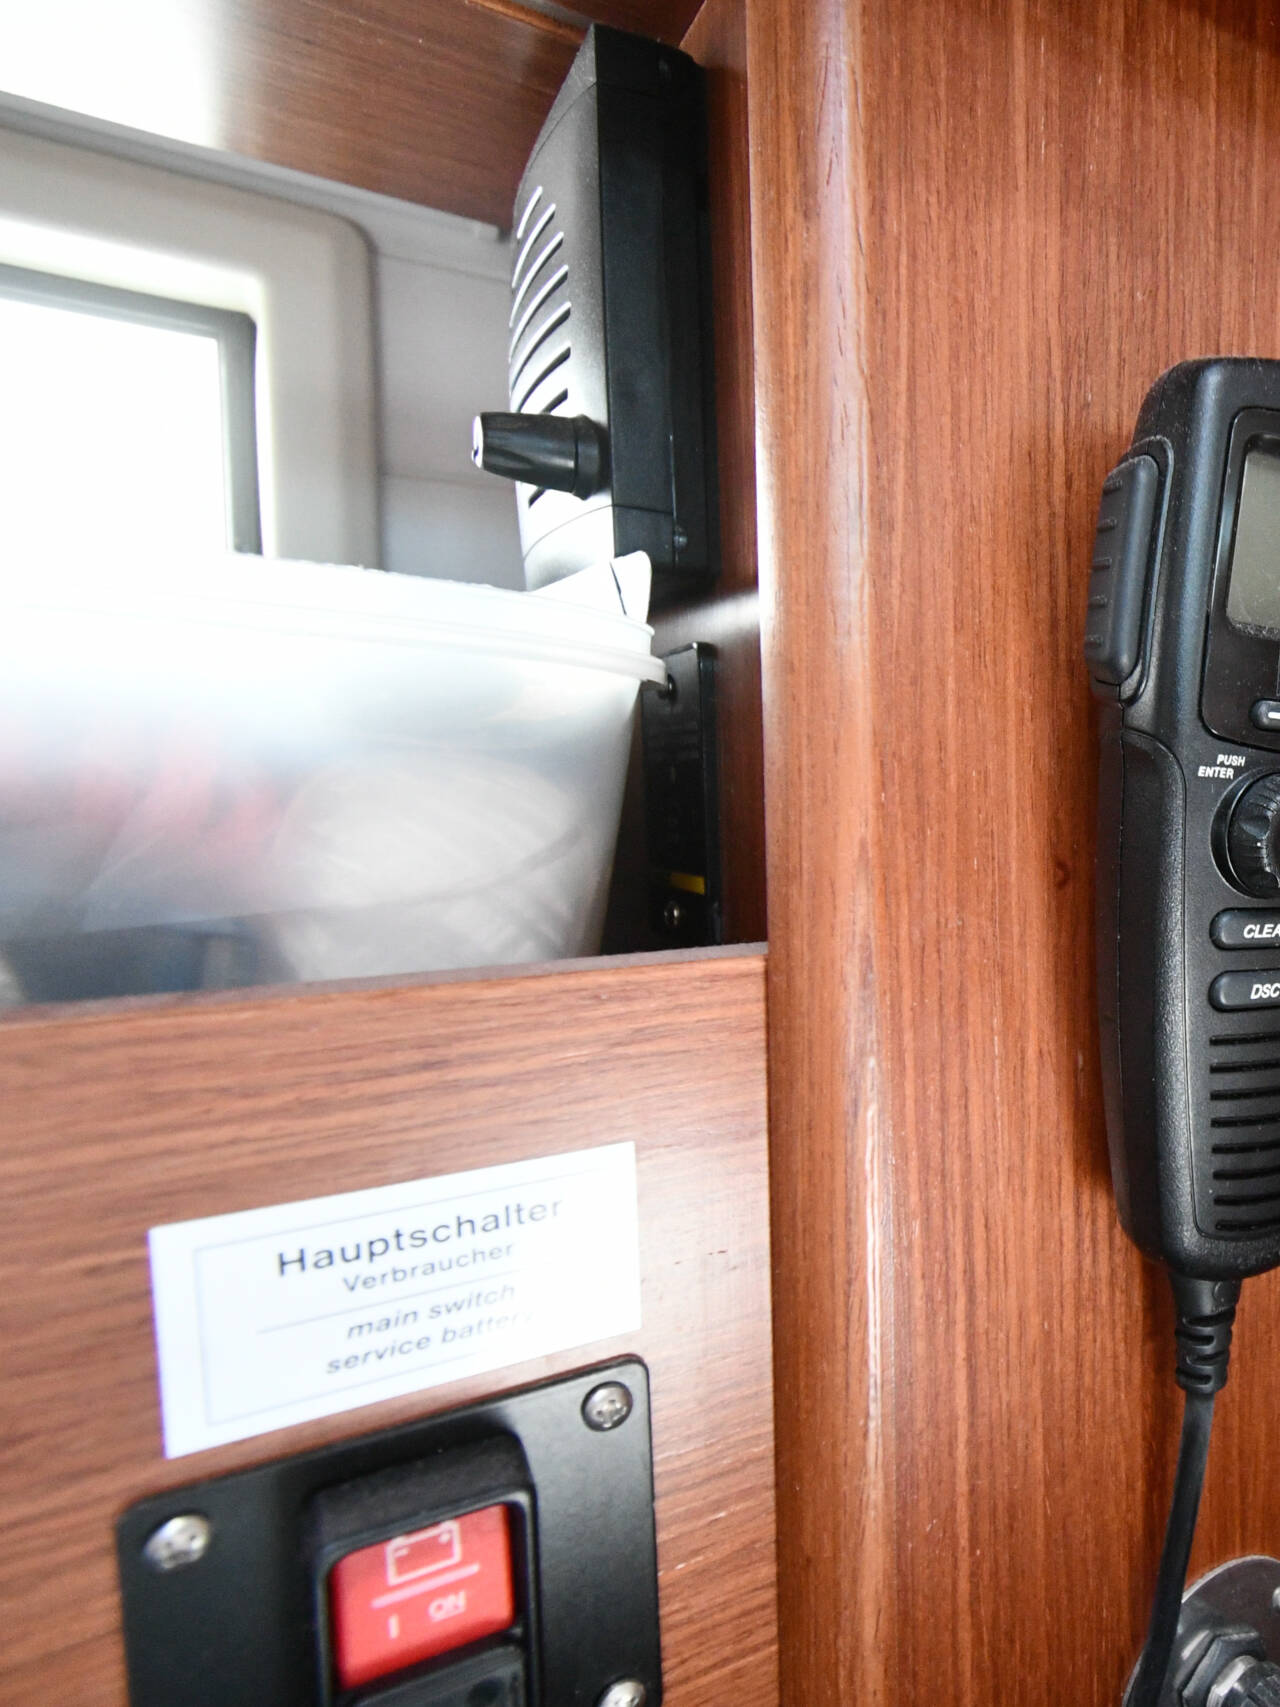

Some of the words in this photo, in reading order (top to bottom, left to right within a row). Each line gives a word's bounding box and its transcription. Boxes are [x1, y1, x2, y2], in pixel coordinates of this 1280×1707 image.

[1197, 765, 1235, 780] ENTER
[1216, 754, 1246, 767] PUSH
[276, 1197, 564, 1278] Hauptschalter
[342, 1241, 515, 1294] Verbraucher
[346, 1307, 420, 1341] main
[427, 1282, 516, 1321] switch
[324, 1333, 432, 1375] service
[427, 1590, 467, 1624] ON
